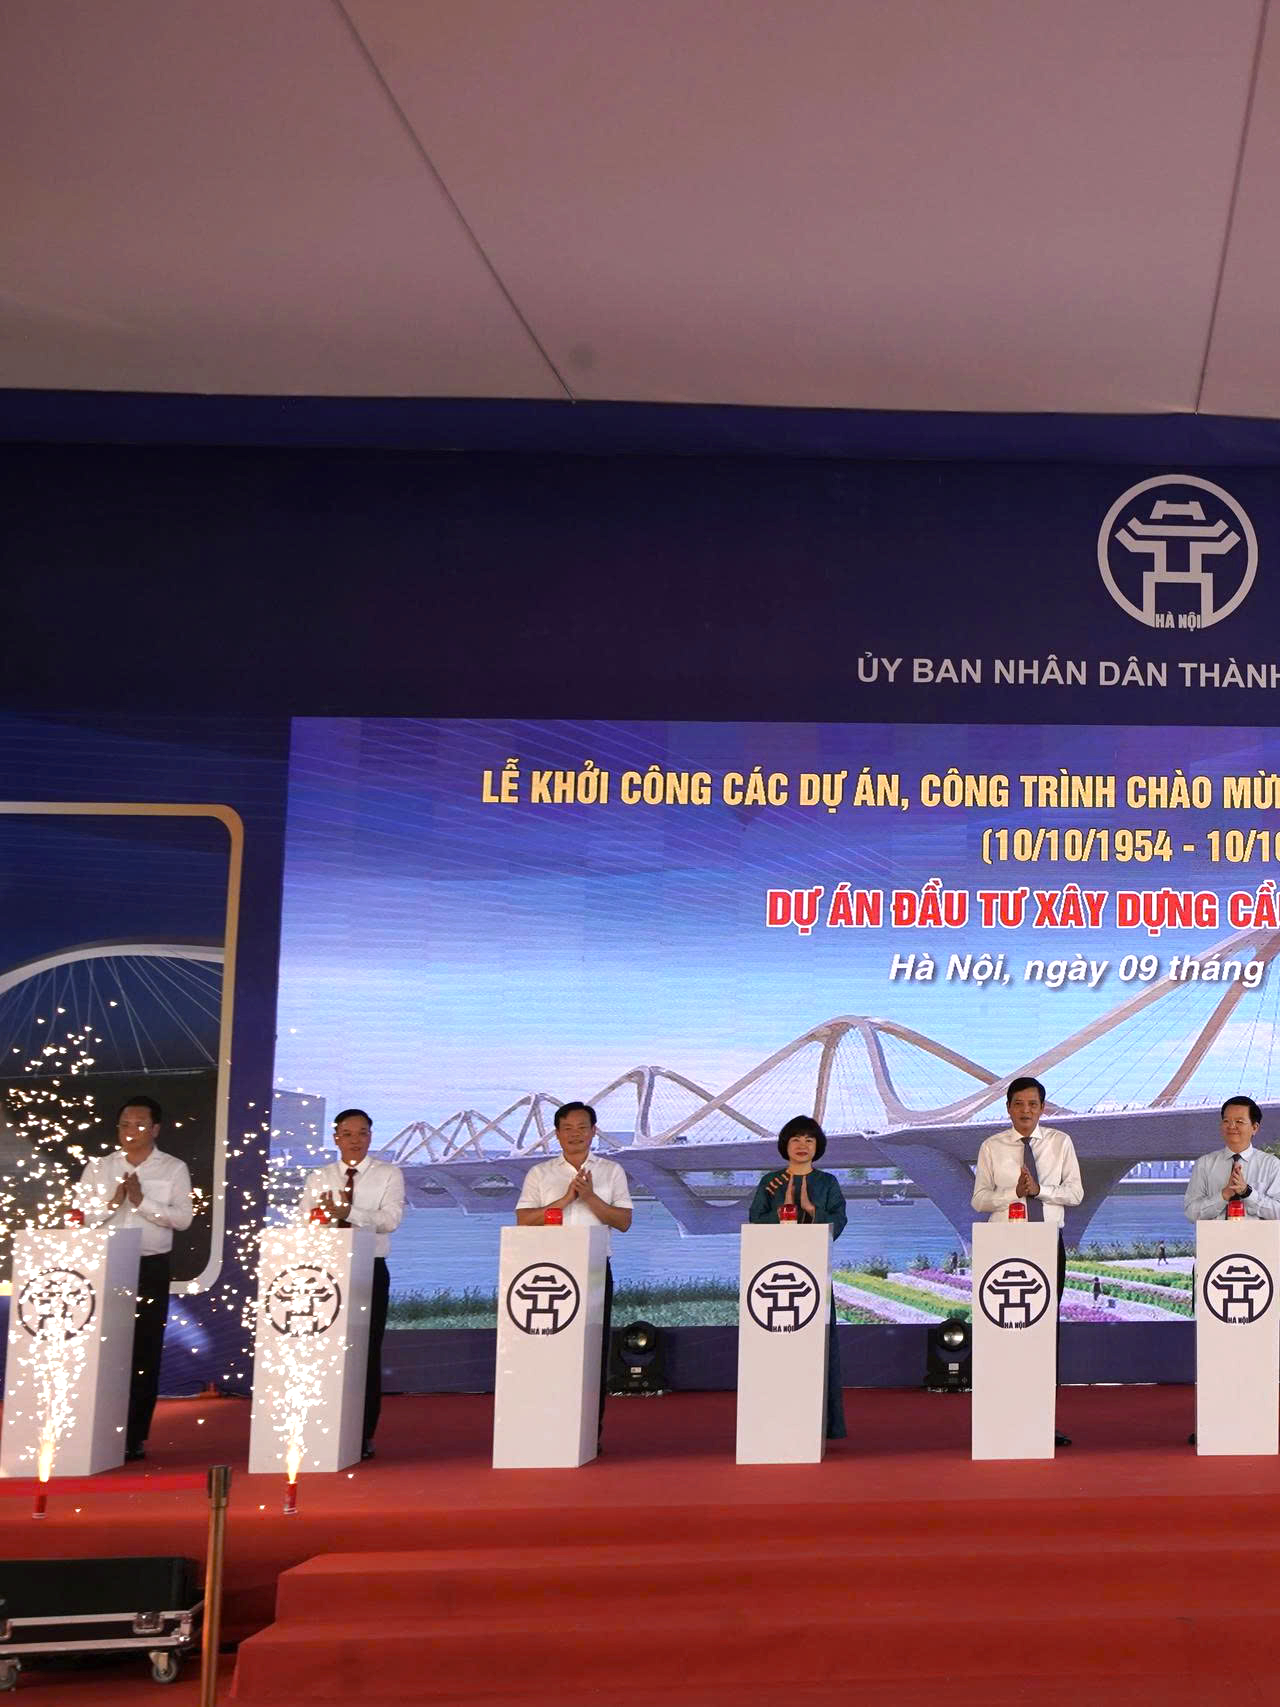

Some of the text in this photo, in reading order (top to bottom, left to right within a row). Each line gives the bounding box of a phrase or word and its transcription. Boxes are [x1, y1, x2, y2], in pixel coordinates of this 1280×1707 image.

[1155, 611, 1201, 632] HÀ NỘI
[857, 651, 903, 683] ỦY
[912, 658, 982, 684] BAN
[994, 654, 1087, 686] NHÂN
[1098, 655, 1167, 687] DÂN
[482, 758, 520, 804] LỄ
[530, 760, 609, 804] KHỞI
[620, 764, 712, 805] CÔNG
[722, 765, 789, 806] CÁC
[799, 769, 848, 814] DỰ
[853, 767, 909, 811] ÁN,
[920, 767, 1009, 808] CÔNG
[1019, 768, 1116, 809] TRÌNH
[1126, 769, 1212, 810] CHÀO
[982, 828, 1173, 865] (10/10/1954
[767, 886, 822, 935] DỰ
[828, 883, 882, 928] ÁN
[891, 878, 968, 928] ĐẦU
[978, 888, 1029, 929] TƯ
[1034, 884, 1106, 929] XÂY
[1115, 887, 1218, 936] DỰNG
[889, 953, 935, 981] Hà
[945, 953, 1011, 987] Nội,
[1023, 955, 1110, 988] ngày
[1118, 954, 1158, 981] 09
[1168, 953, 1265, 988] tháng
